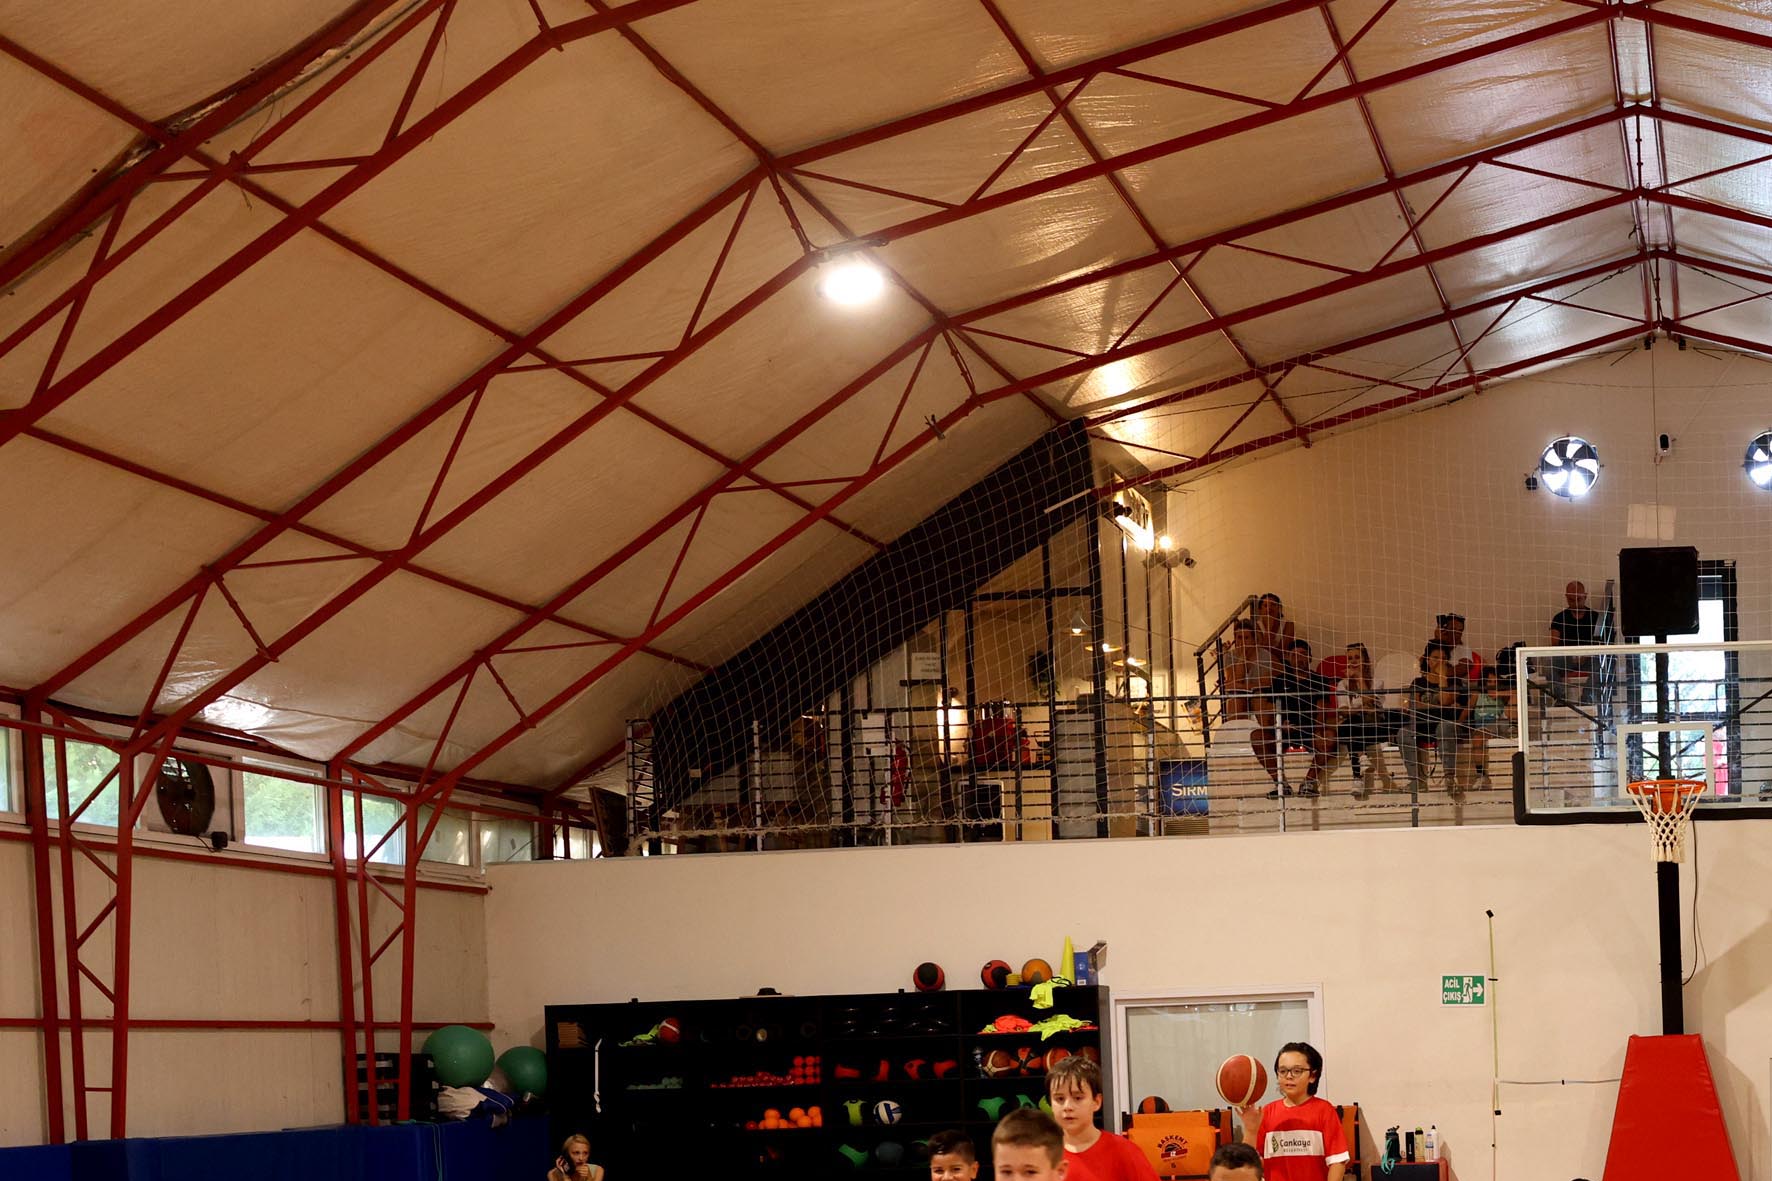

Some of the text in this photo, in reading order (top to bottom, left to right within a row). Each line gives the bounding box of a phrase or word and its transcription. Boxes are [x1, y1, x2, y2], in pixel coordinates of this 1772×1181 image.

[1444, 976, 1460, 989] ACİL
[1443, 991, 1462, 1004] ÇIKIŞ
[1279, 1138, 1311, 1148] Çankaya
